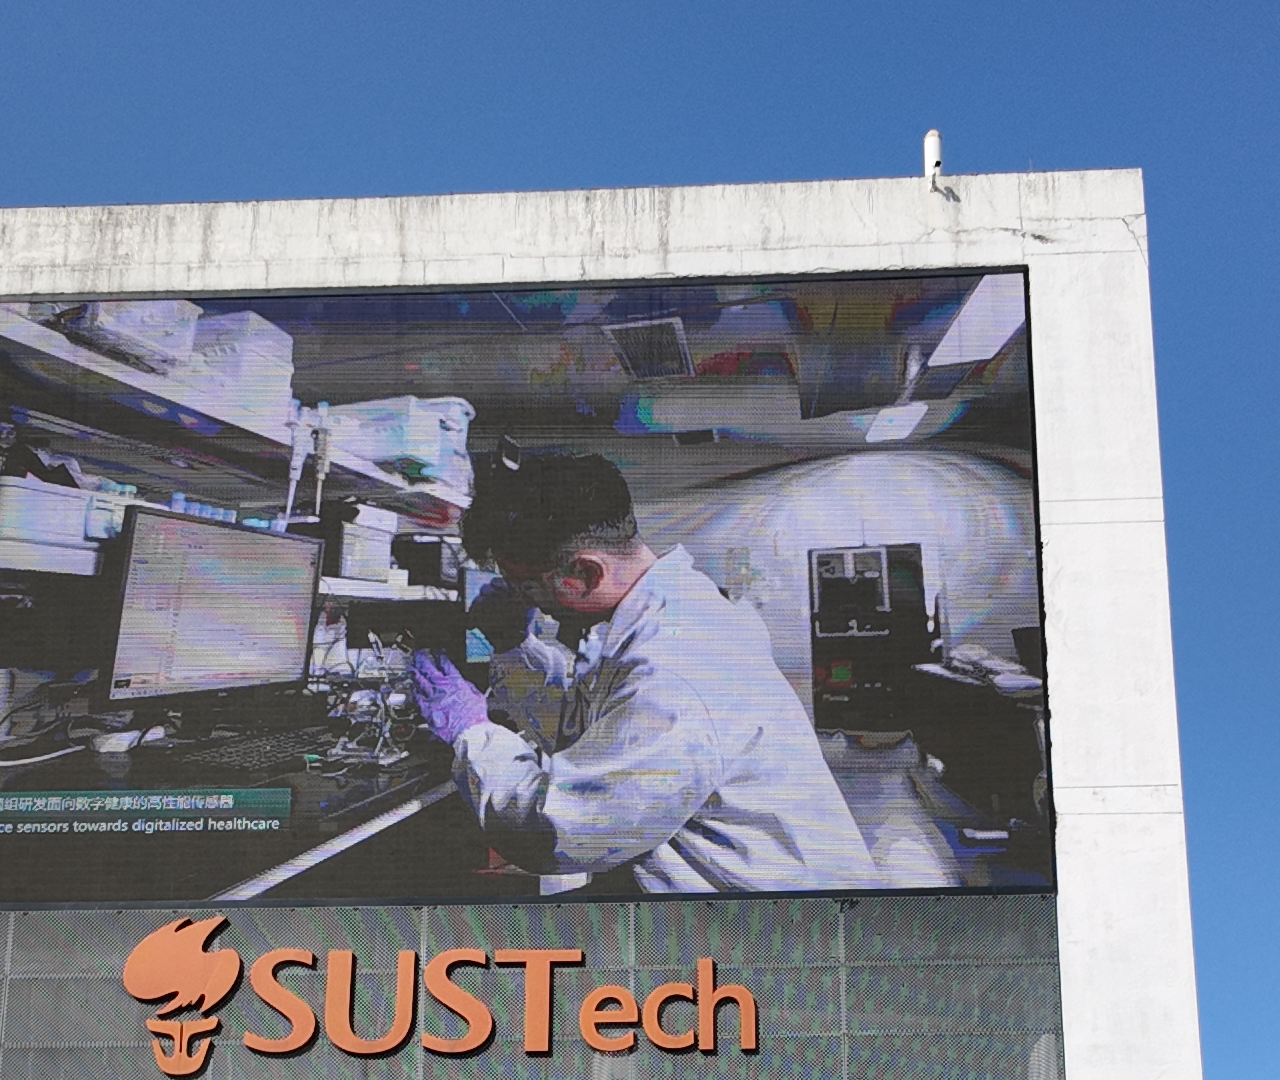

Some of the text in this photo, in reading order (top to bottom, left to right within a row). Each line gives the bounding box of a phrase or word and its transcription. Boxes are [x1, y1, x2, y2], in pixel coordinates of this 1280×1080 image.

[16, 821, 69, 833] sensors
[73, 819, 129, 832] towards
[131, 818, 203, 834] digitalized
[208, 817, 280, 831] healthcare
[244, 948, 758, 1055] SUSTech
